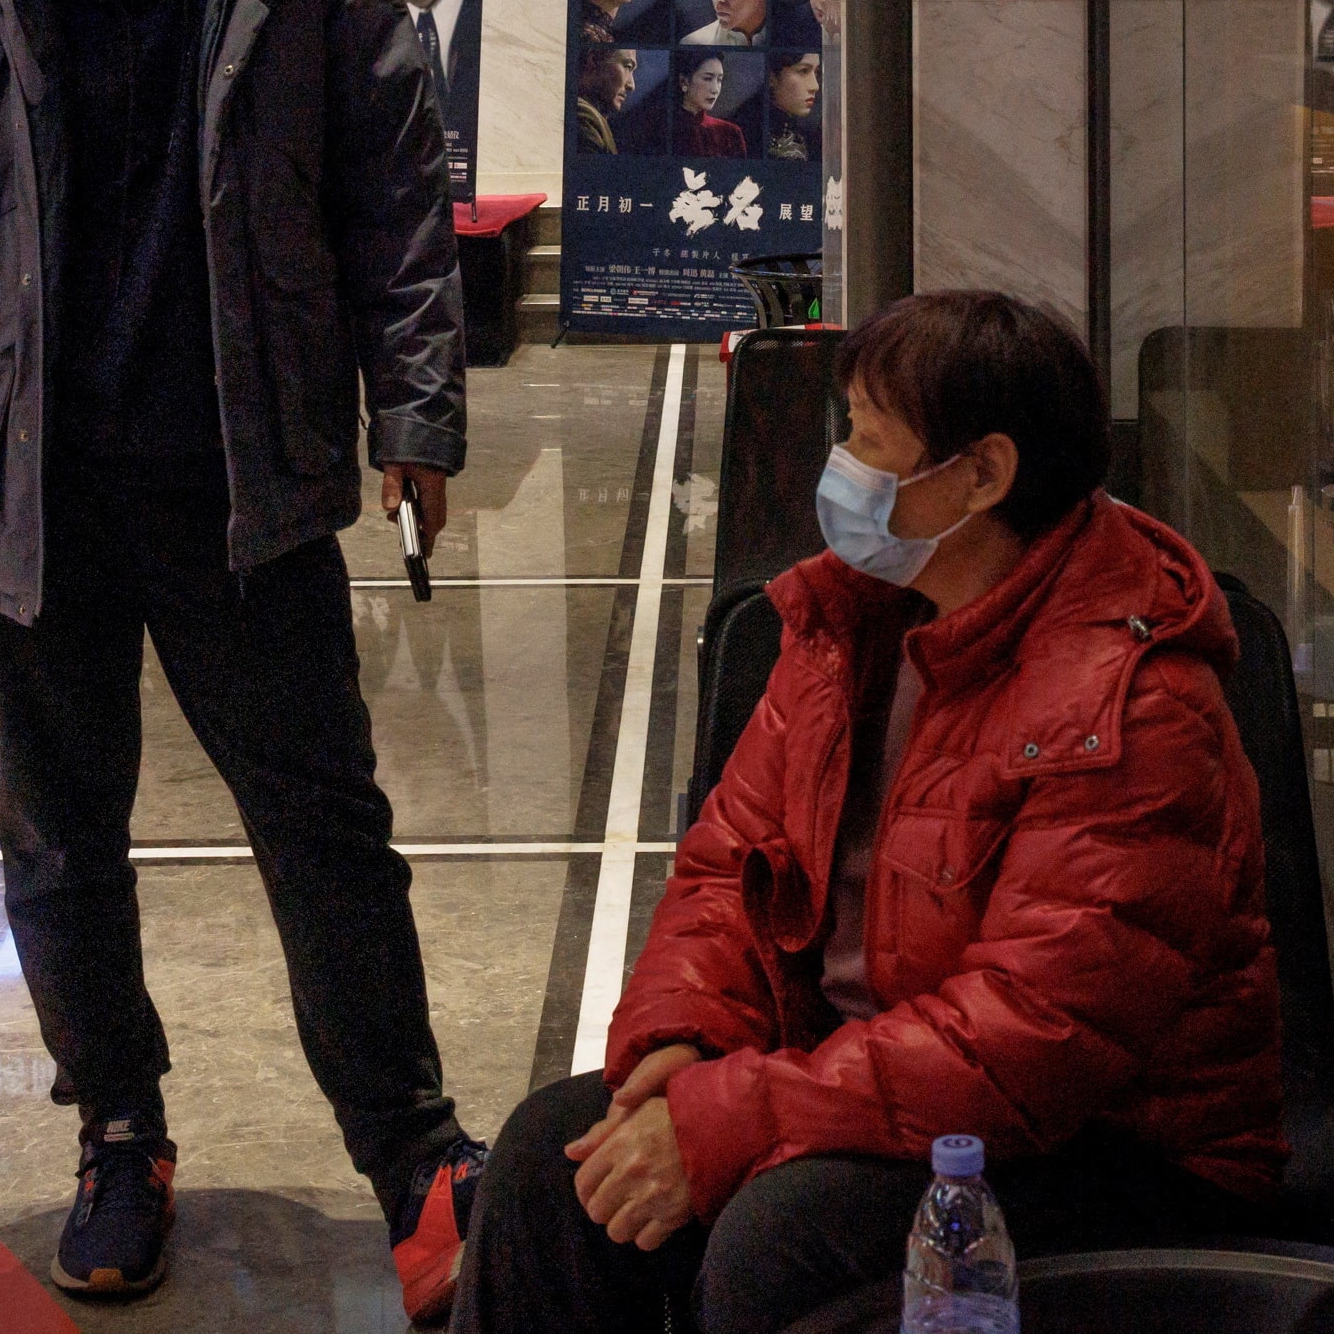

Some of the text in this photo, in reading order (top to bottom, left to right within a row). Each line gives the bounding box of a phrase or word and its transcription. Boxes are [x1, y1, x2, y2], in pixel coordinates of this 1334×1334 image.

[576, 195, 654, 214] 正月初一
[778, 203, 814, 222] 展望
